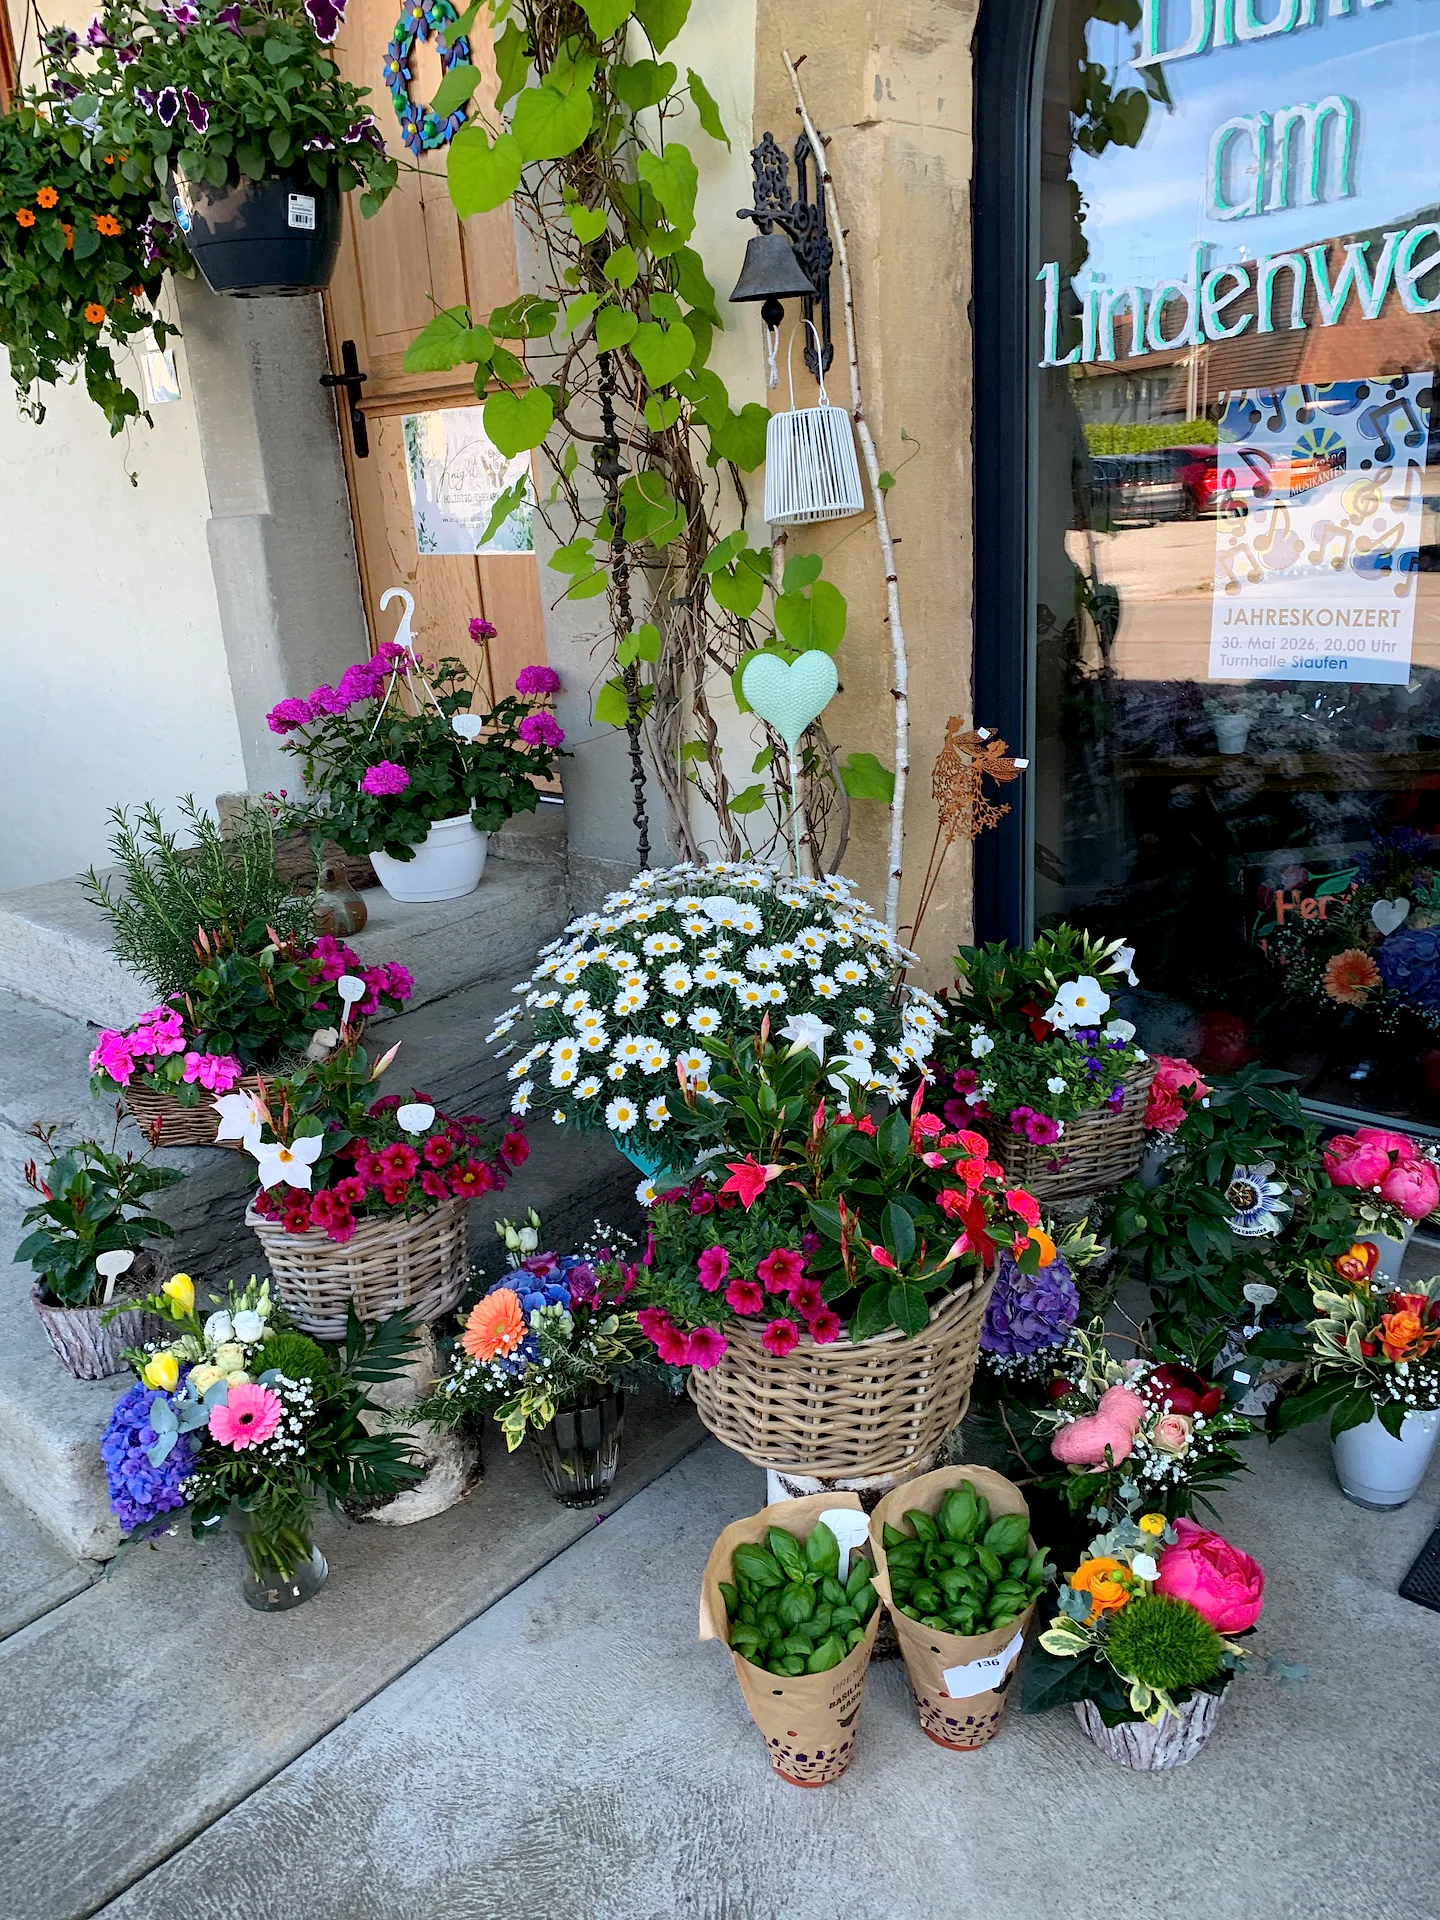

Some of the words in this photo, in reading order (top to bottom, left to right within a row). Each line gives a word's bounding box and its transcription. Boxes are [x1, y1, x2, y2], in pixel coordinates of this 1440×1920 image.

[1206, 94, 1355, 222] am
[1290, 463, 1346, 497] MUSIKANTEN
[1223, 607, 1401, 628] JAHRESKONZERT
[1221, 636, 1242, 649] 30.
[1247, 636, 1276, 650] Mai
[1280, 637, 1319, 652] 2026,
[1323, 638, 1366, 652] 20.00
[1371, 639, 1397, 653] Uhr
[1220, 653, 1287, 669] Turnhalle
[1291, 655, 1348, 670] Staufen
[976, 1658, 1000, 1668] 136
